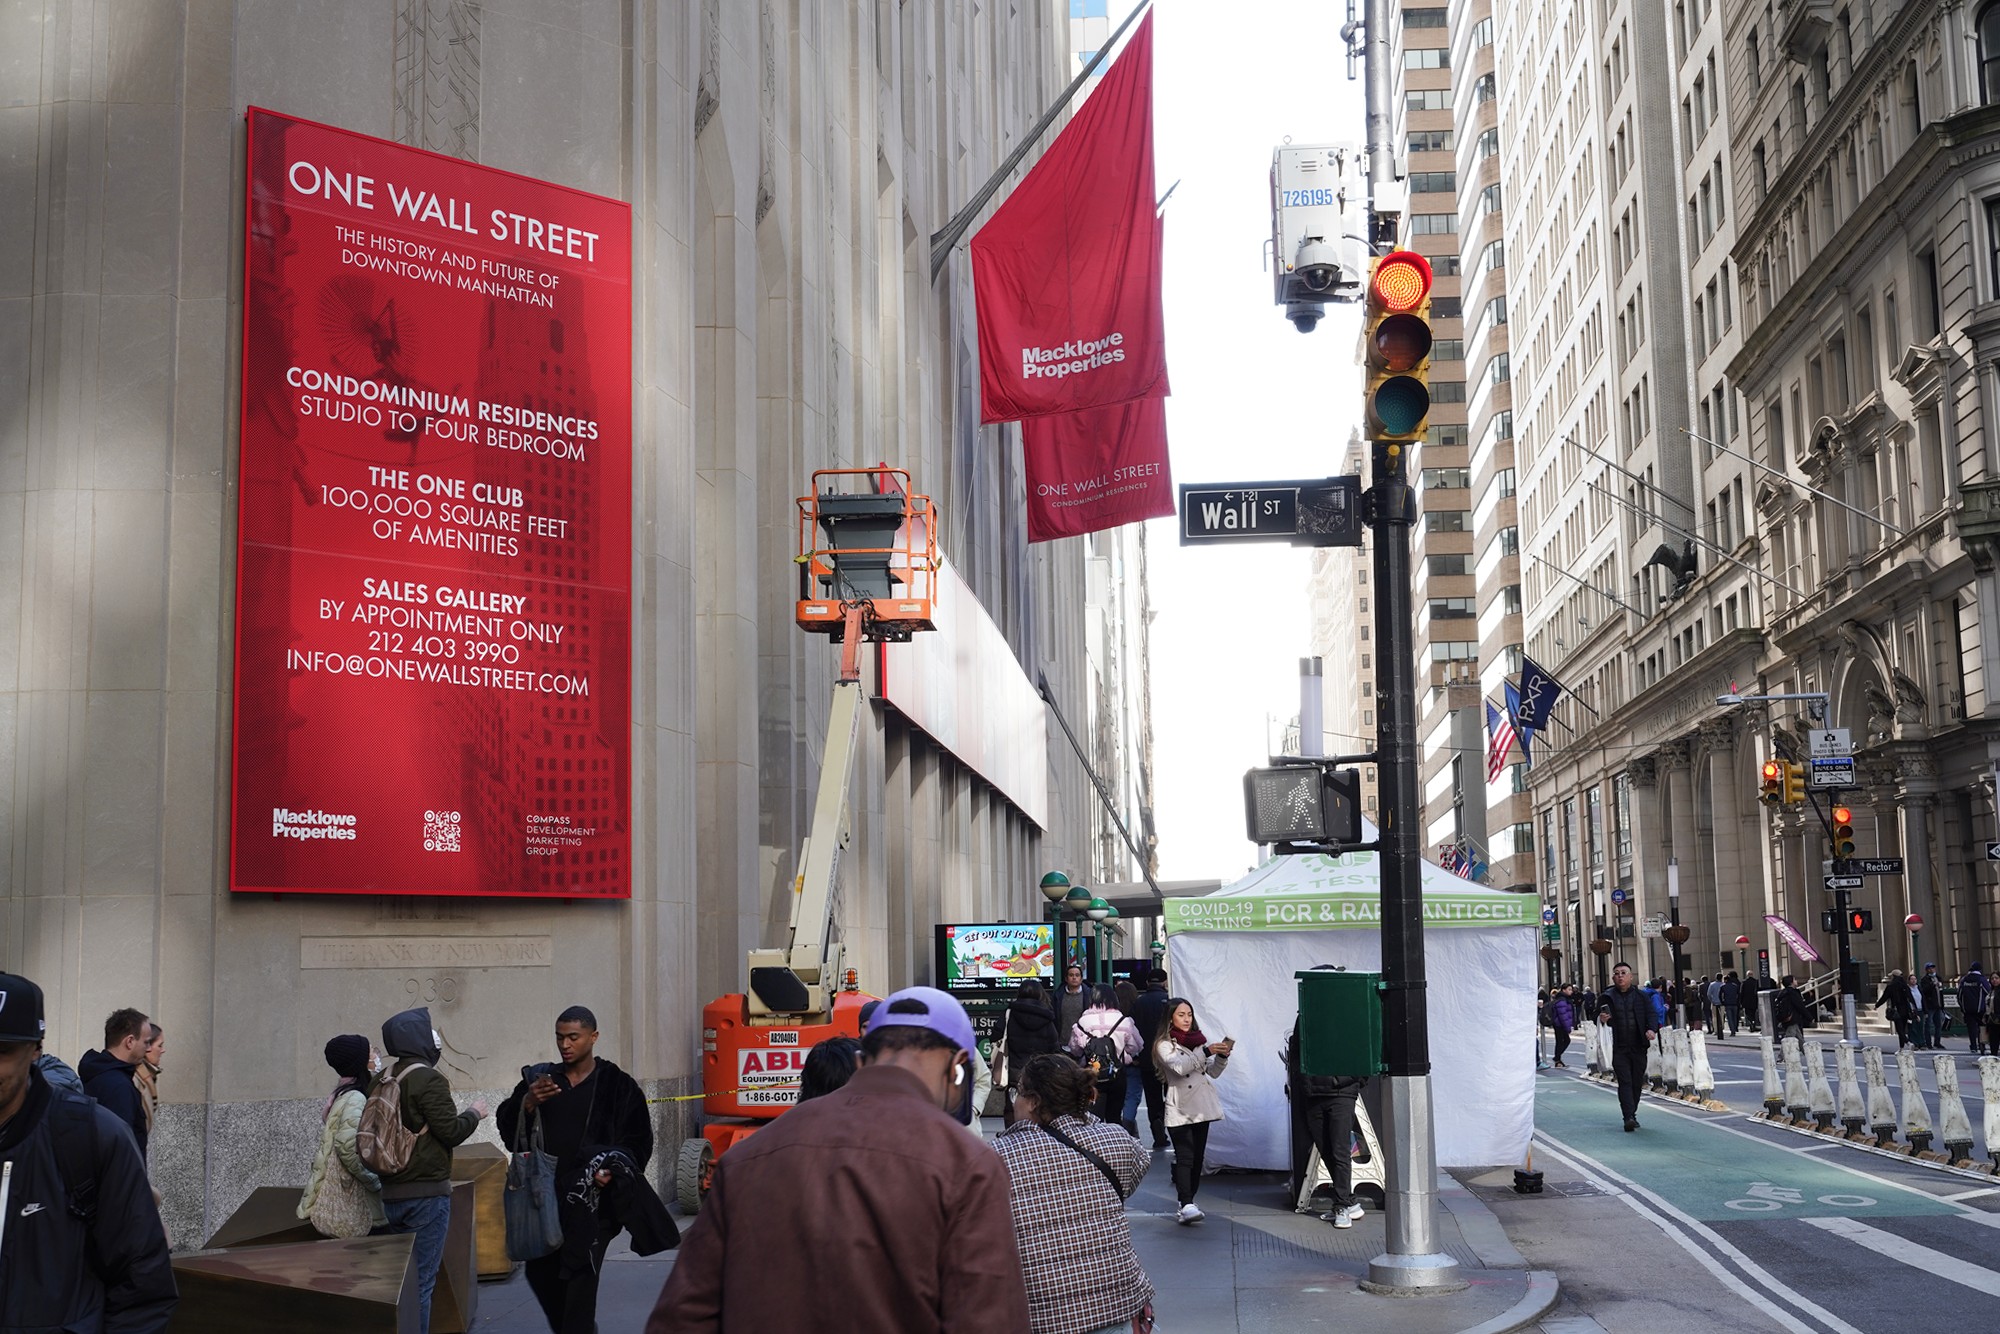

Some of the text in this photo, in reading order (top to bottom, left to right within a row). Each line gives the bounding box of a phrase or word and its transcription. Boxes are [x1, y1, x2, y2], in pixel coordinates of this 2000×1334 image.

[1283, 189, 1333, 207] 726195
[289, 160, 600, 262] ONE WALL STREET
[335, 225, 560, 290] THE HISTORY AND FUTURE OF
[342, 248, 554, 309] DOWNTOWN MANHATTAN
[1022, 332, 1124, 365] Macklowe
[1022, 348, 1126, 379] Properties
[286, 366, 599, 440] CONDOMINIUM RESIDENCES
[300, 394, 586, 462] STUDIO TO FOUR BEDROOM
[368, 465, 524, 508] THE ONE CLUB
[1037, 462, 1161, 497] ONE WALL STREET
[1051, 482, 1148, 508] CONDOMINIUM RESIDENCES
[1241, 491, 1258, 501] 1-21
[321, 484, 568, 539] 100,000 SQUARE FEET
[1201, 500, 1281, 530] Wall ST
[372, 519, 519, 557] OF AMENITIES
[363, 577, 526, 615] SALES GALLERY
[319, 599, 564, 645] BY APPOINTMENT ONLY
[368, 631, 520, 665] 212 403 3990
[287, 648, 590, 697] INFO@ONEWALLSTREET.COM
[1519, 675, 1548, 721] RXR
[273, 808, 357, 826] Macklowe
[526, 814, 571, 825] COMPASS
[272, 823, 357, 841] Properties
[526, 825, 596, 836] DEVELOPMENT
[526, 836, 582, 847] MARKETING
[525, 846, 559, 856] GROUP
[1866, 862, 1892, 872] Rector
[1264, 881, 1299, 894] EZ
[1179, 901, 1253, 917] COVID-19
[1265, 902, 1523, 924] PCR & RAP ANTIGEN
[1182, 915, 1253, 929] TESTING
[964, 931, 979, 943] GET
[981, 930, 999, 939] OUT
[999, 929, 1012, 939] OF
[1013, 929, 1038, 942] TOWN
[770, 1032, 798, 1044] AB2040E4
[983, 1042, 992, 1055] 5
[741, 1051, 806, 1076] ABL
[742, 1075, 793, 1083] EQUIPMENT
